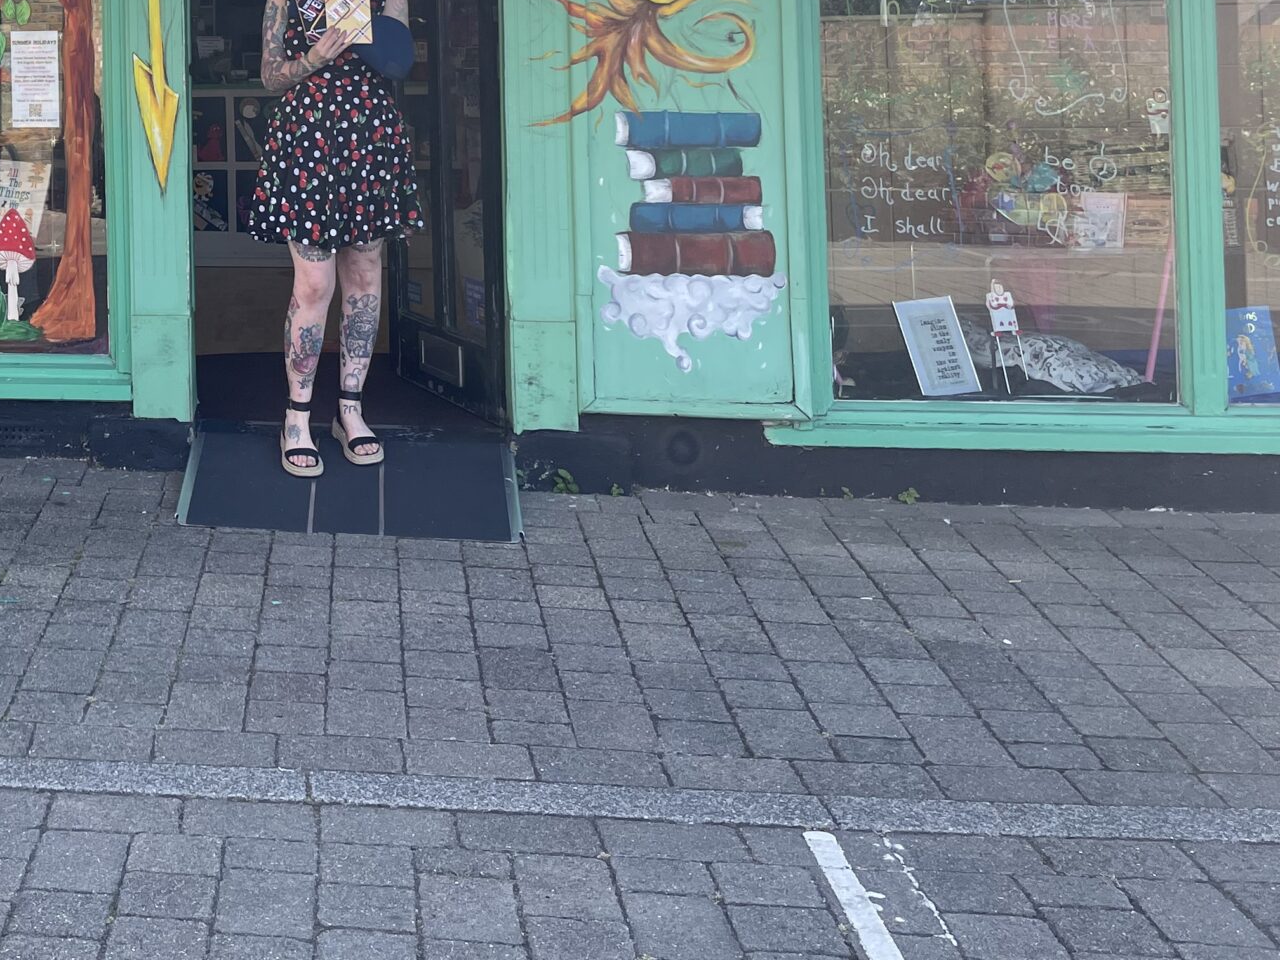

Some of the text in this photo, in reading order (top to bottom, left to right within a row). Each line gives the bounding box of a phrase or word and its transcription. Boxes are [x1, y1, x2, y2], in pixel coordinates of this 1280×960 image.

[861, 142, 898, 172] Oh
[1045, 145, 1076, 170] be
[7, 167, 19, 178] All
[9, 178, 22, 188] The
[0, 186, 31, 202] Things
[861, 176, 895, 205] Oh
[860, 214, 944, 238] I shall
